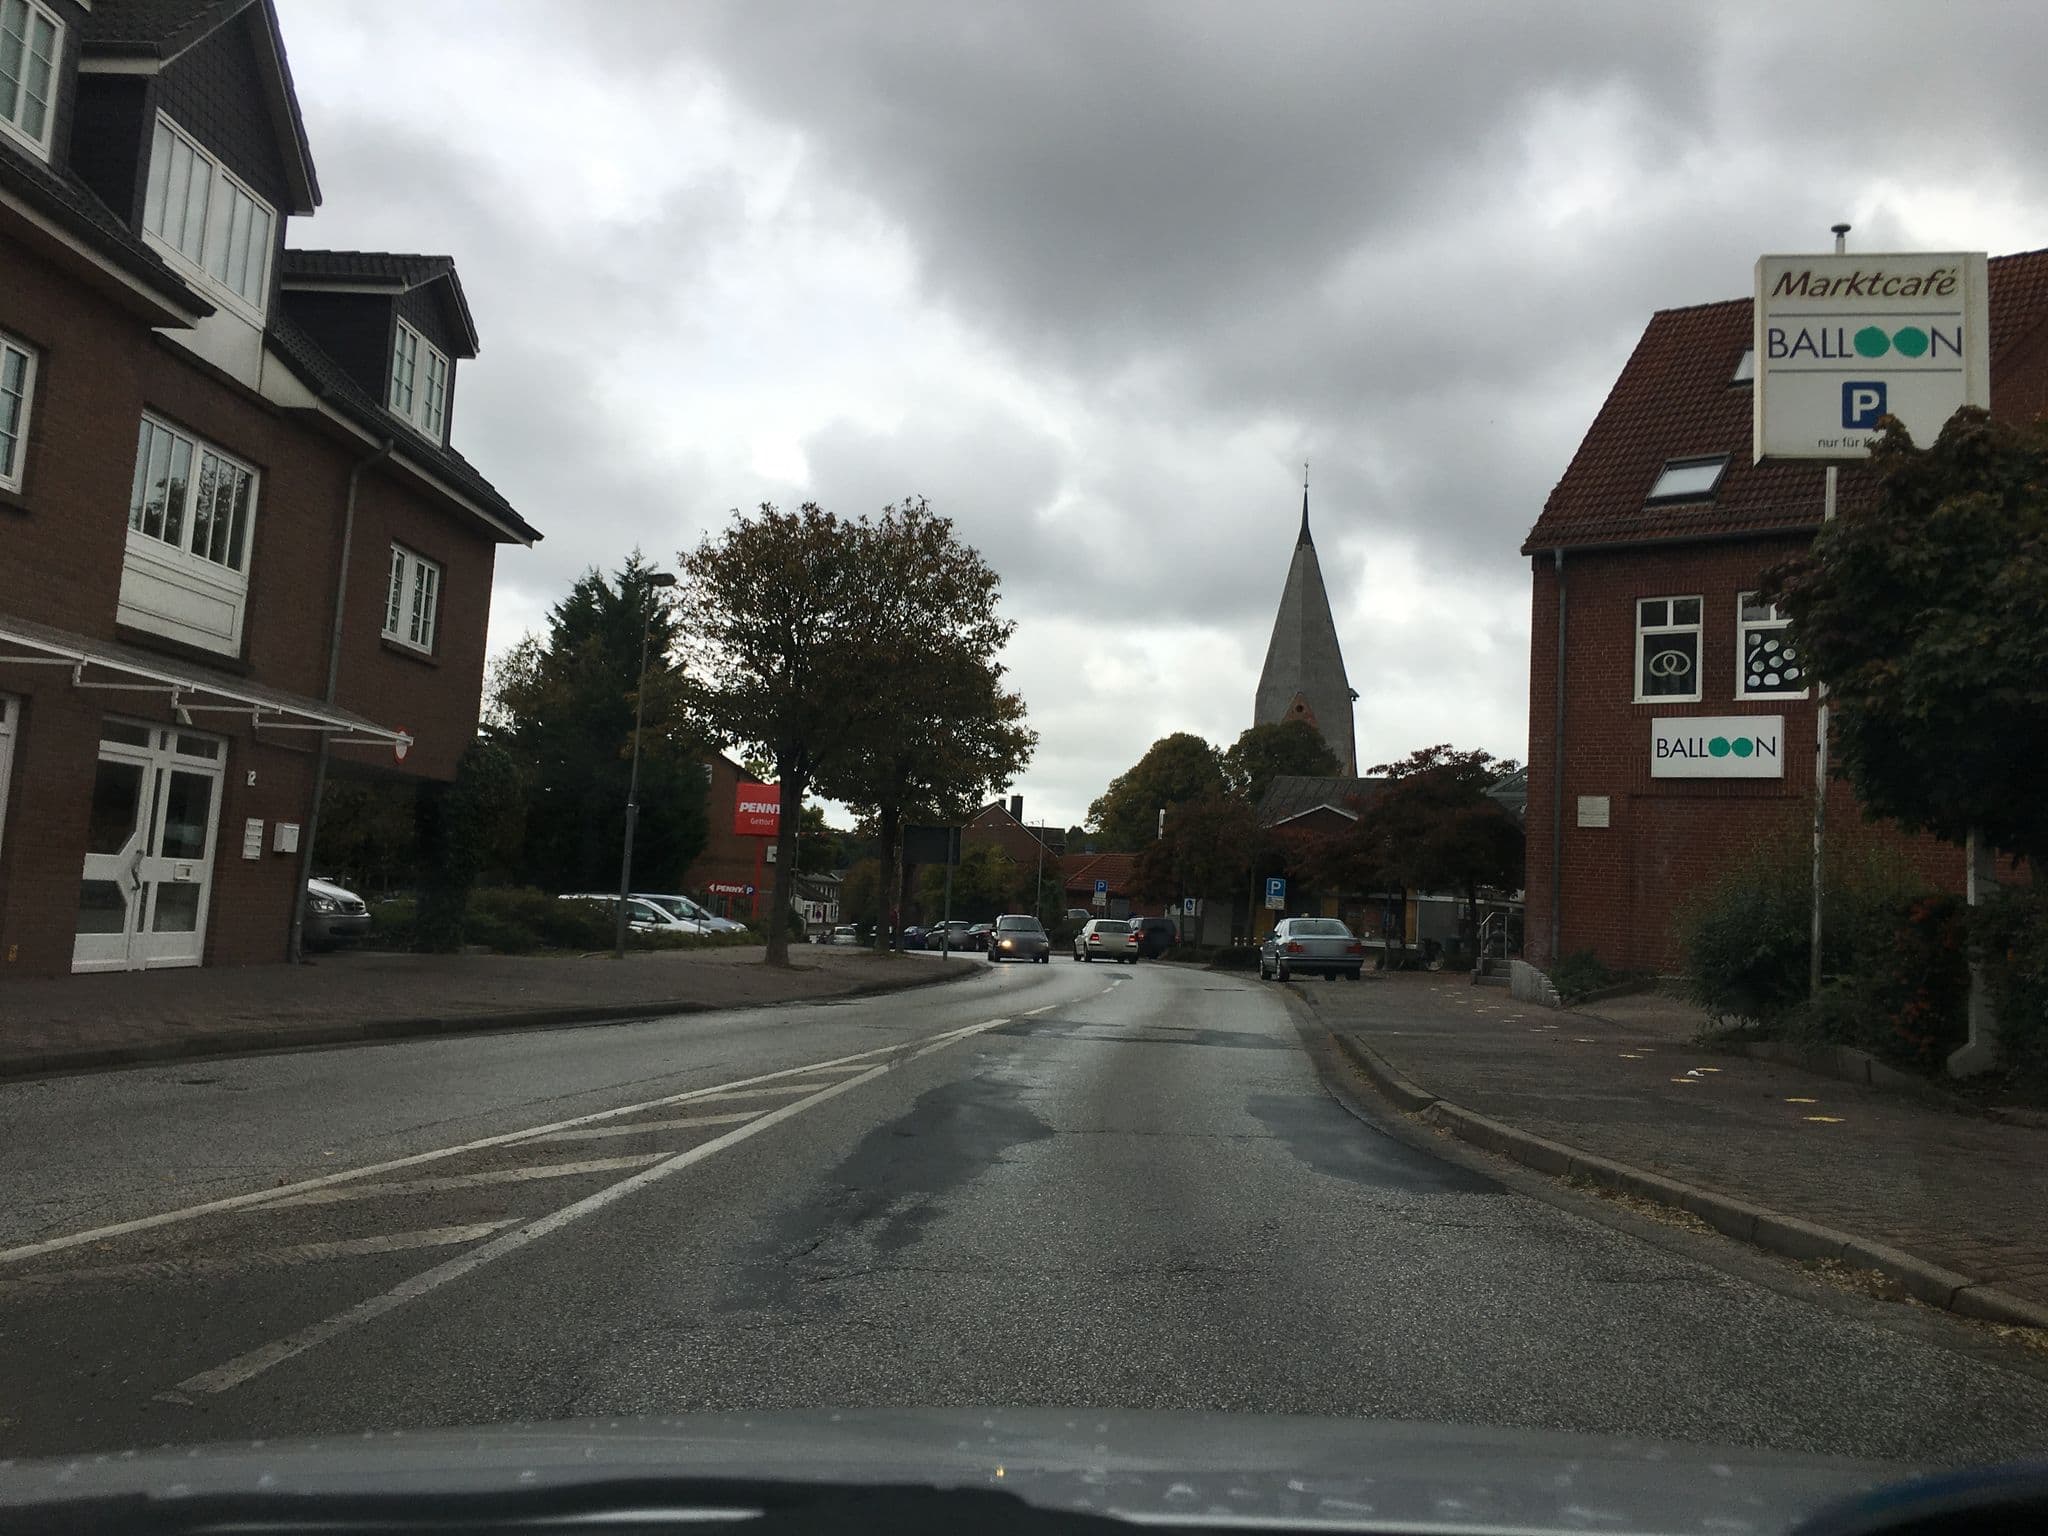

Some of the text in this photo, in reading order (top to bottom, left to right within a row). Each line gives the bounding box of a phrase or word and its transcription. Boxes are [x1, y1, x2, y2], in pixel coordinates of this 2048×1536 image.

[1771, 266, 1959, 298] Marktcafé
[1767, 325, 1963, 359] BALLOON
[1851, 389, 1880, 423] P
[1817, 438, 1840, 448] nur
[1842, 436, 1860, 448] für
[1655, 736, 1777, 759] BALLOON
[1271, 880, 1281, 894] P
